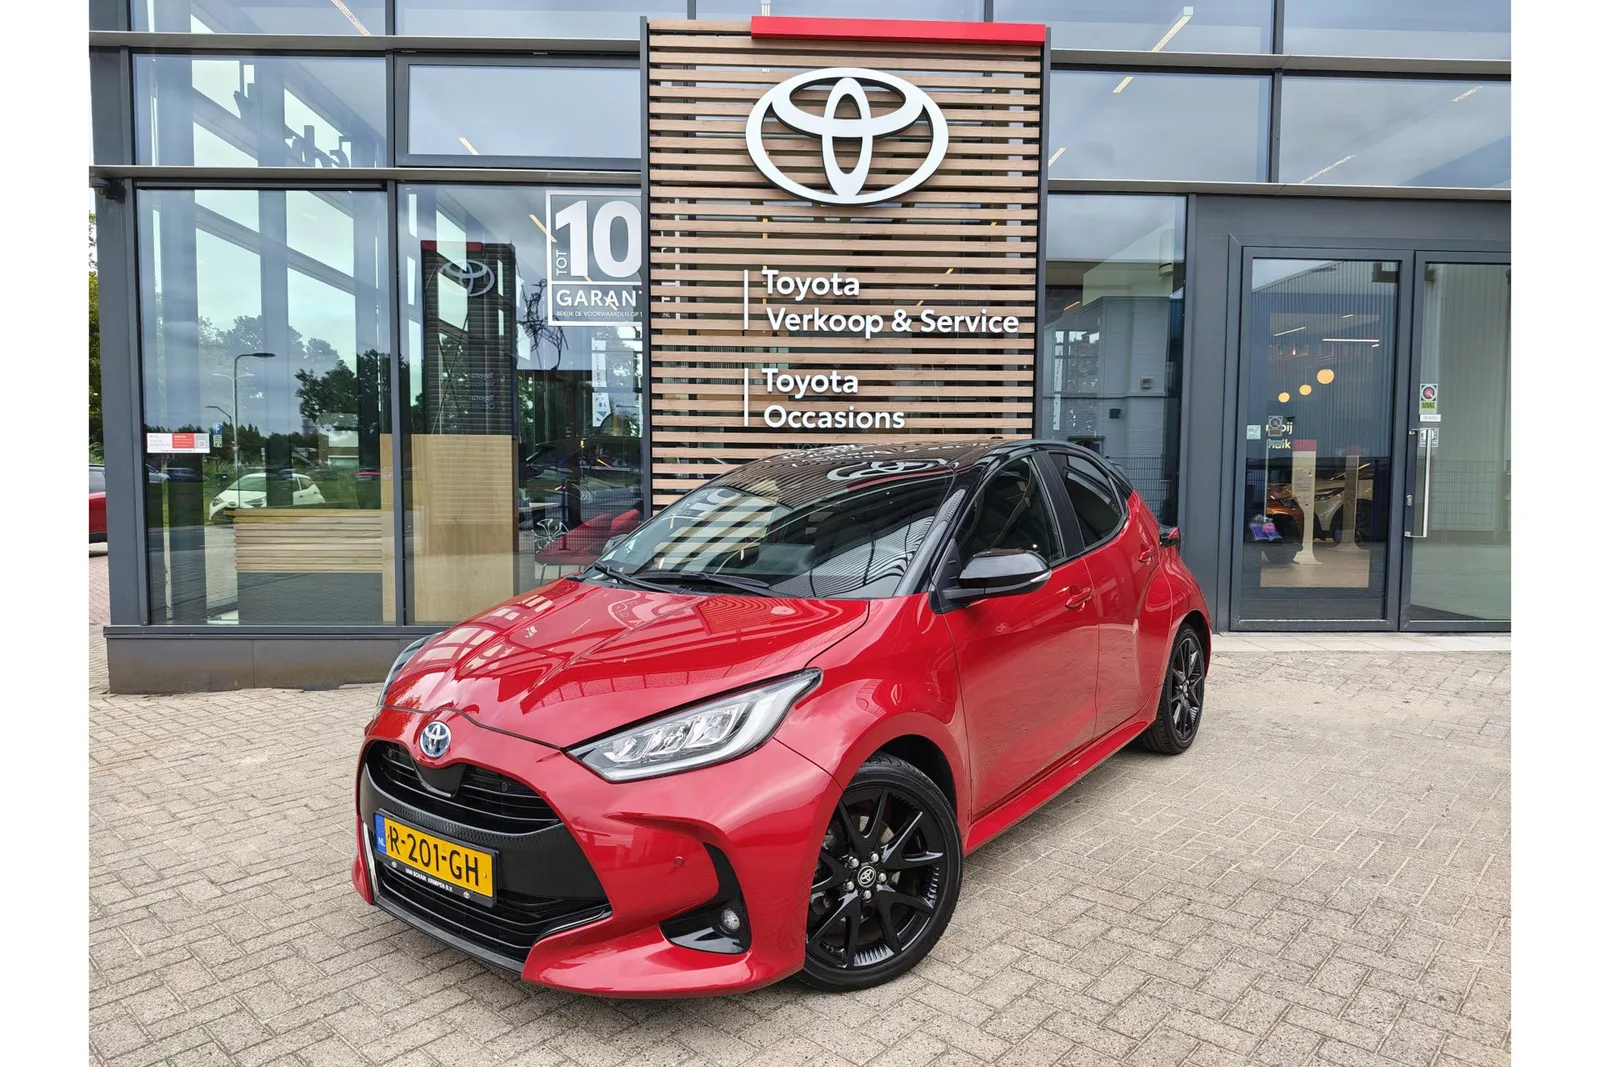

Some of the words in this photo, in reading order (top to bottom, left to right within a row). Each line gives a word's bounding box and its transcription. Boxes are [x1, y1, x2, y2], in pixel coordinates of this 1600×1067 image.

[555, 200, 642, 278] 10
[556, 250, 567, 276] TOT
[556, 289, 642, 307] GARAN
[762, 269, 860, 301] Toyota
[766, 307, 884, 340] Verkoop
[891, 308, 913, 333] &
[920, 308, 1020, 333] Service
[761, 368, 858, 399] Toyota
[763, 405, 905, 429] Occasions
[388, 825, 479, 887] R-201-GH
